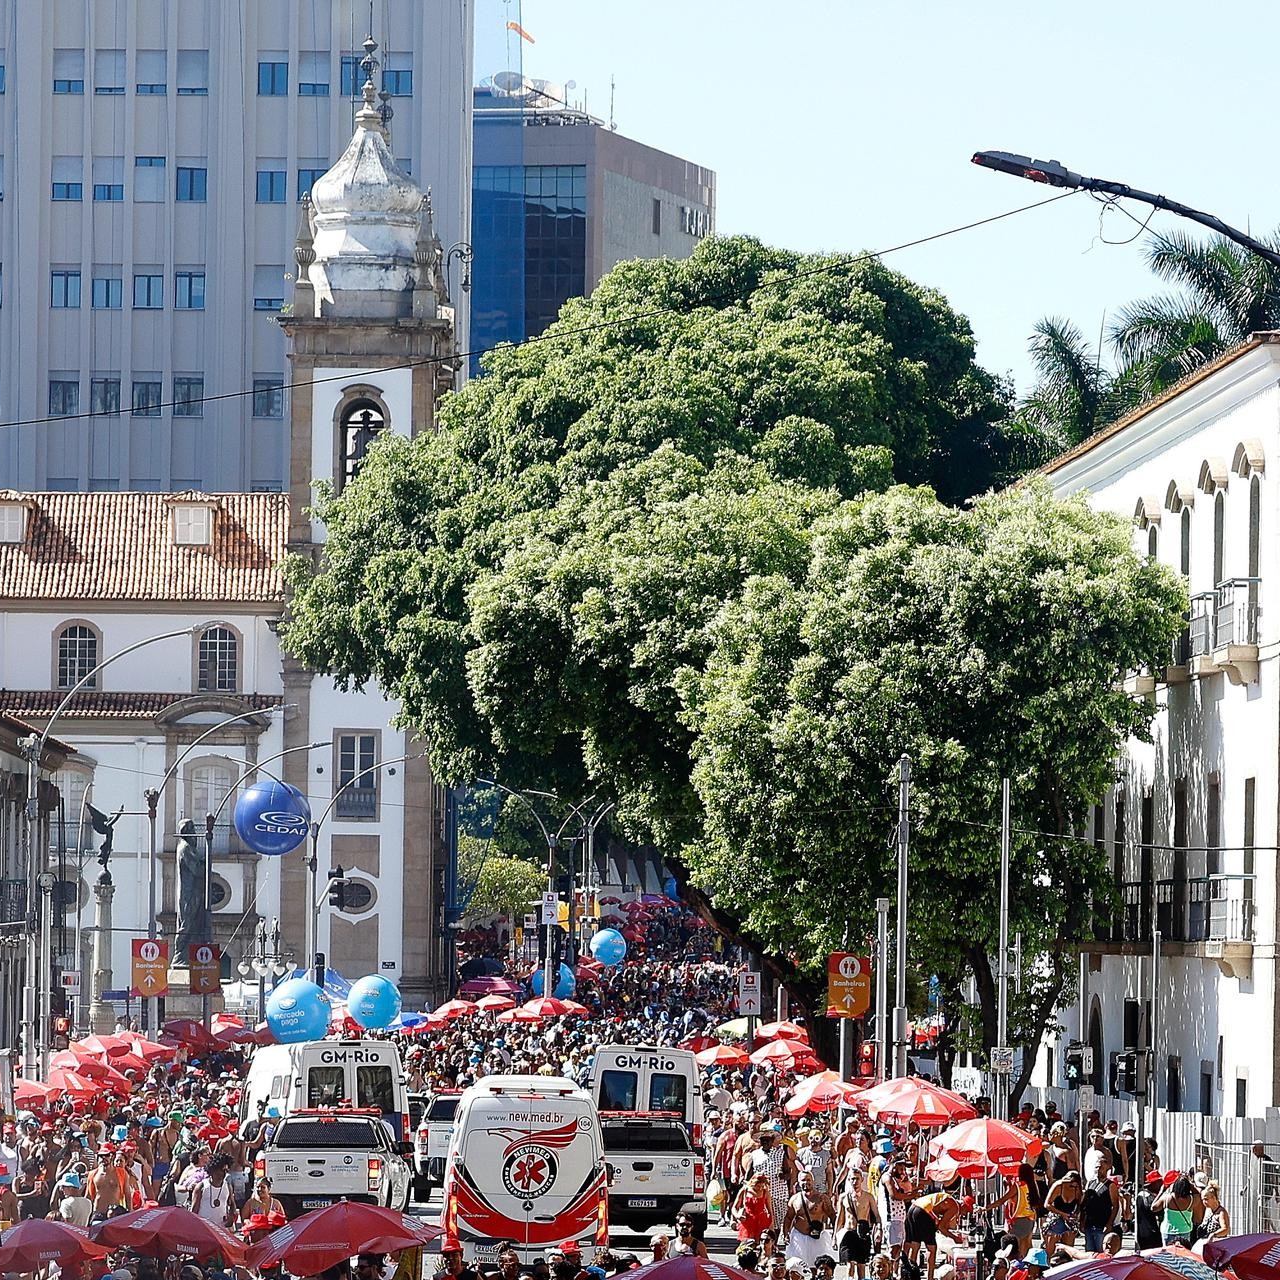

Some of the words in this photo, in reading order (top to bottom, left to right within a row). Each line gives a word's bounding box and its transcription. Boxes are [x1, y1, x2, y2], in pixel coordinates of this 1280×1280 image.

[255, 824, 306, 836] CEDAE
[274, 1011, 305, 1020] mercado
[281, 1018, 299, 1027] pago
[320, 1049, 380, 1064] GM-Rio
[615, 1055, 676, 1071] GM-Rio
[285, 1165, 299, 1173] Rio
